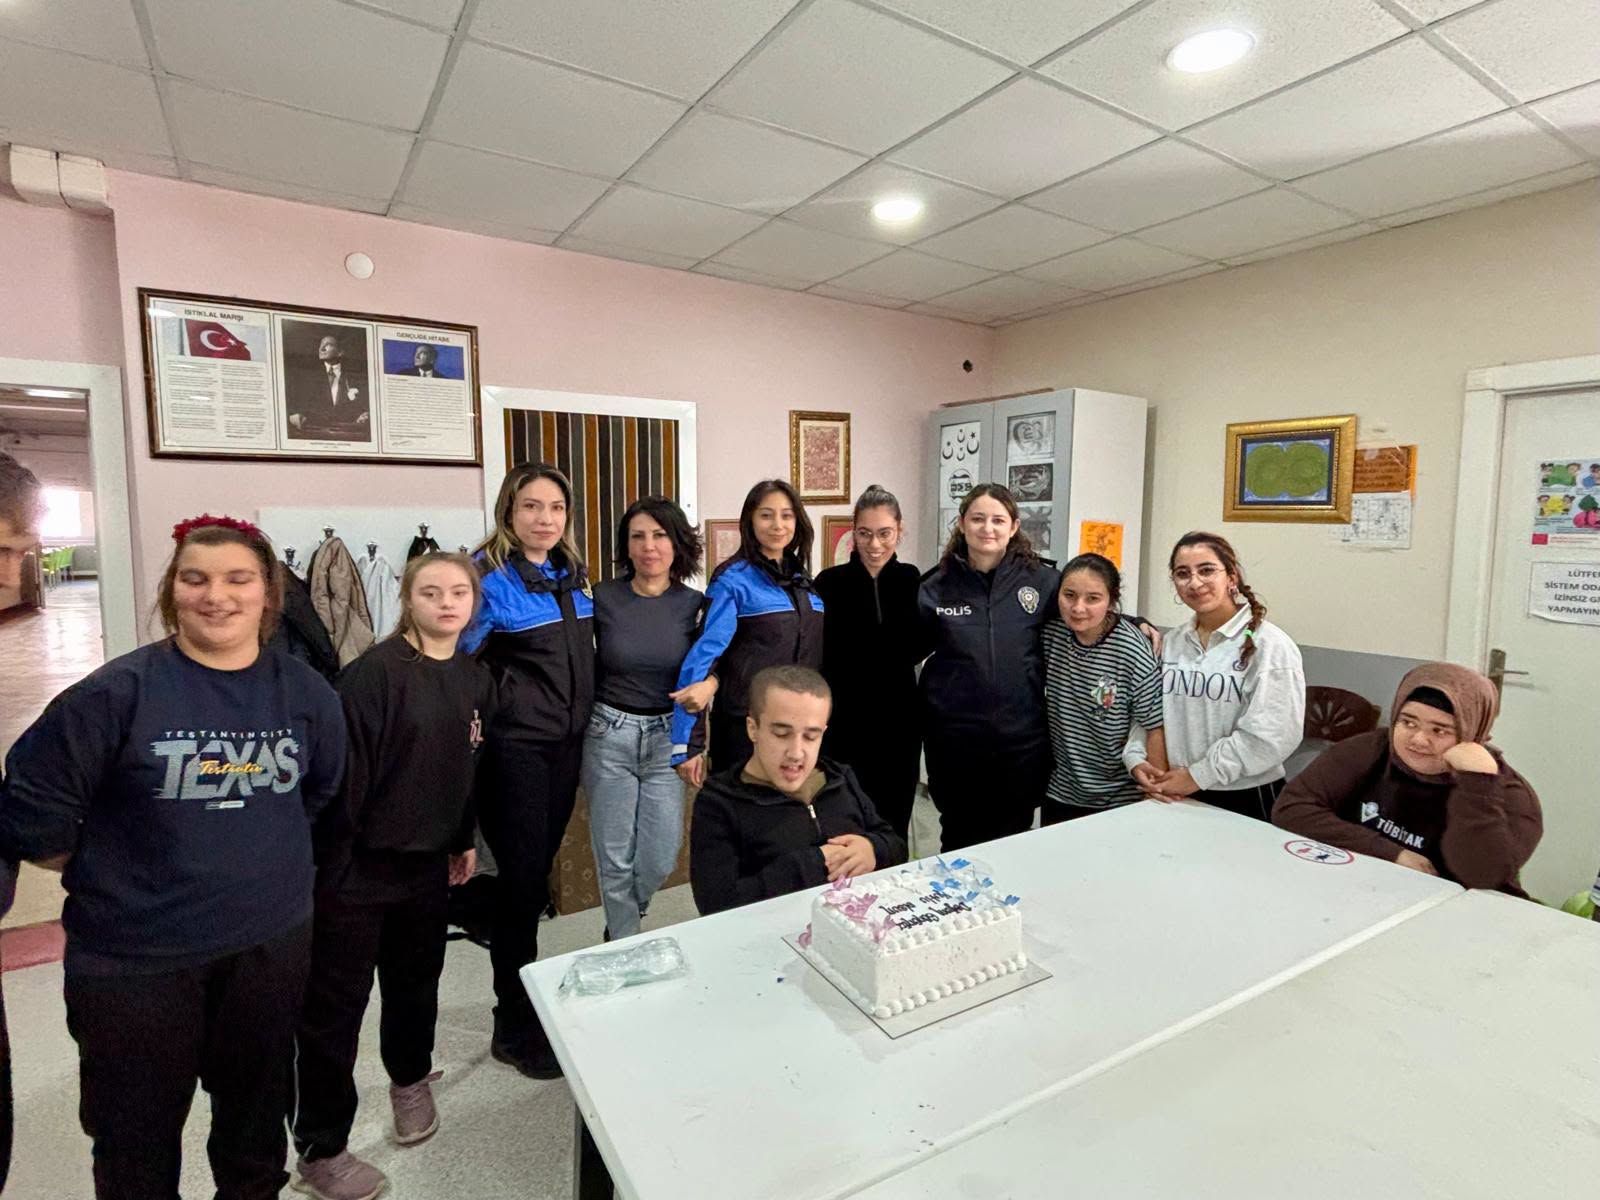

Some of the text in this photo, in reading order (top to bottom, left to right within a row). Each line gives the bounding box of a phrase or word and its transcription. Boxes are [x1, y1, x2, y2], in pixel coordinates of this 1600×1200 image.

[1568, 568, 1600, 578] LÜTFE
[1544, 580, 1580, 590] SİSTEM
[1162, 668, 1245, 703] ONDON
[150, 738, 300, 800] TEXAS
